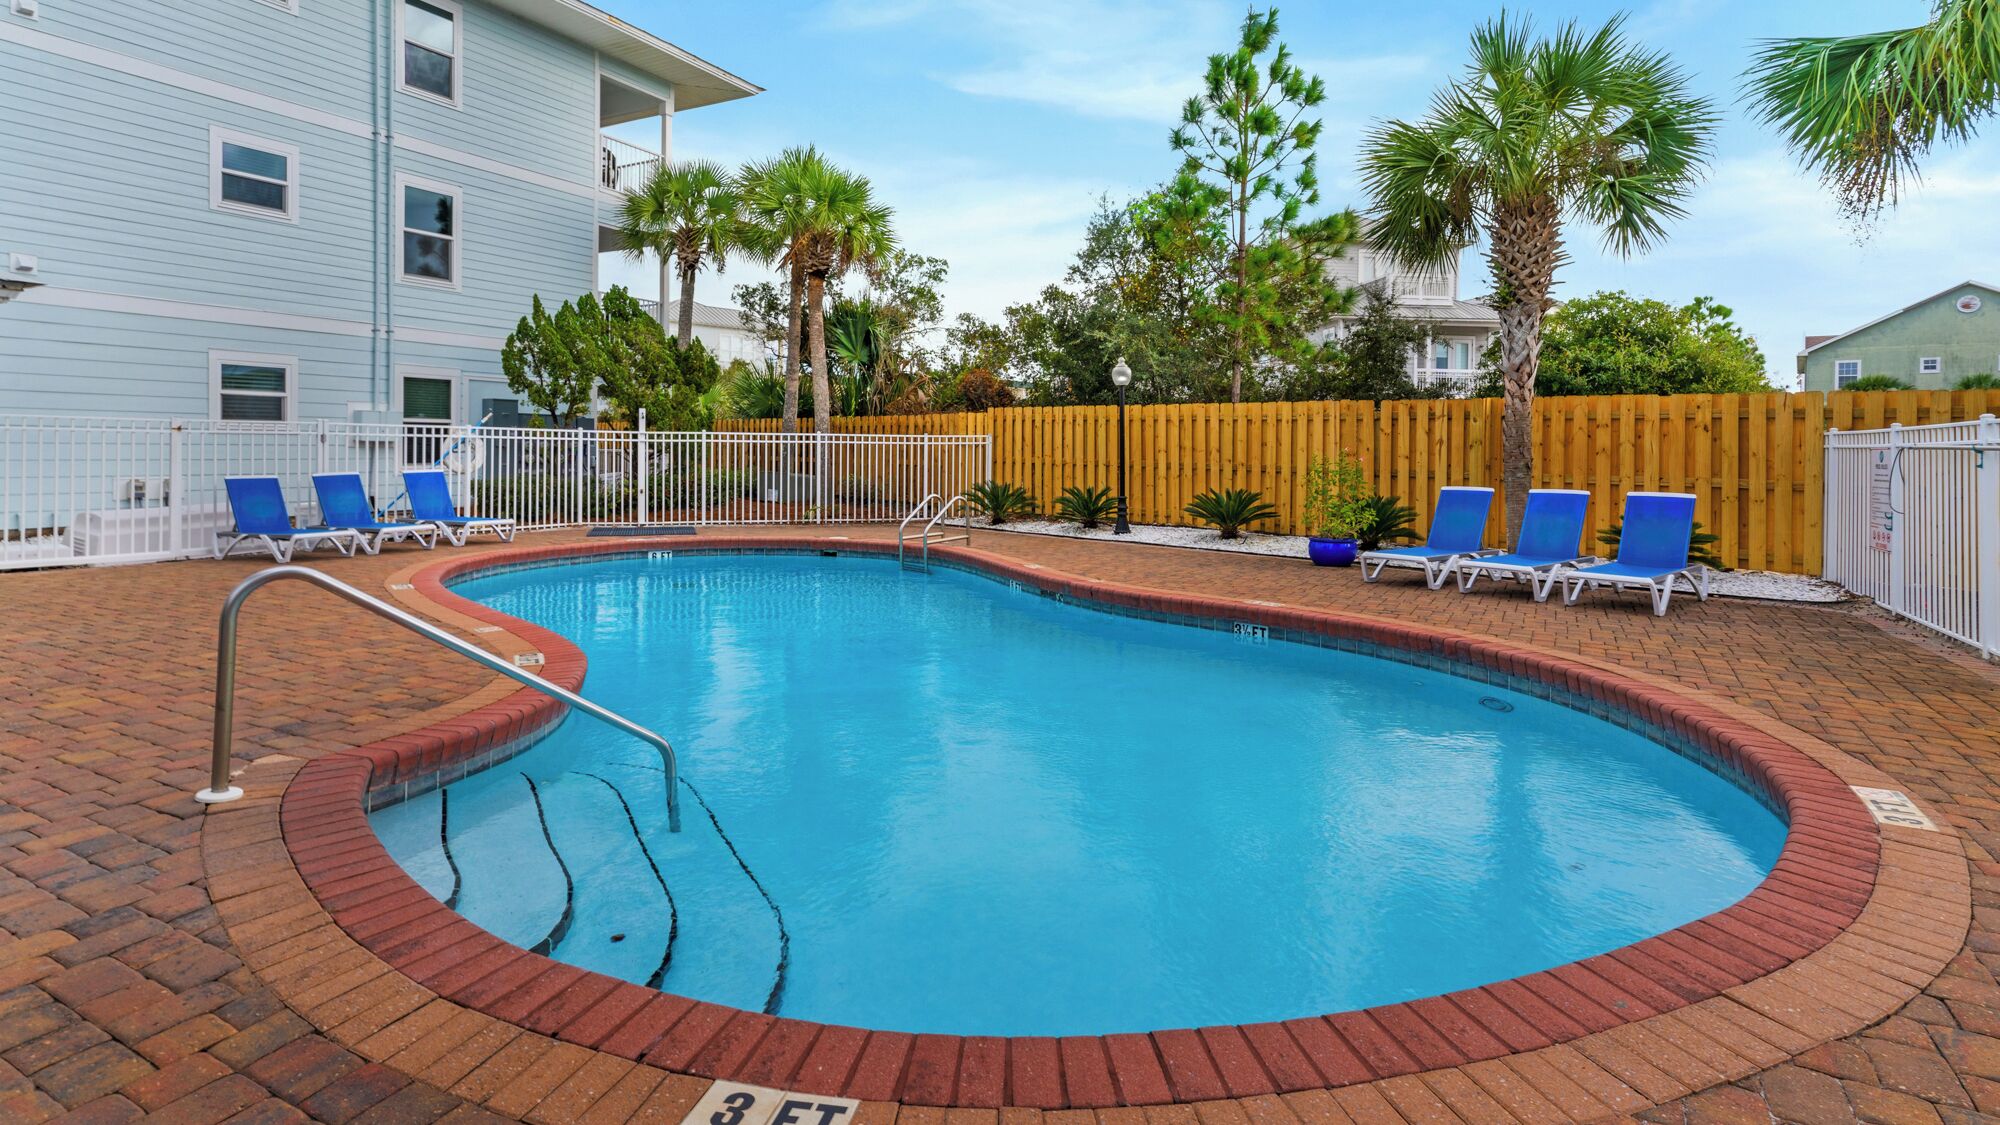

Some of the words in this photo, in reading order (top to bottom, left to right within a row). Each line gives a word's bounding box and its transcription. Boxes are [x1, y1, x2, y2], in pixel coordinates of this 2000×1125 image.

[661, 551, 671, 559] FT
[1252, 626, 1267, 638] FT
[1870, 799, 1917, 815] FT
[1883, 815, 1924, 825] 3
[710, 1092, 756, 1125] 3
[772, 1100, 848, 1125] FT
